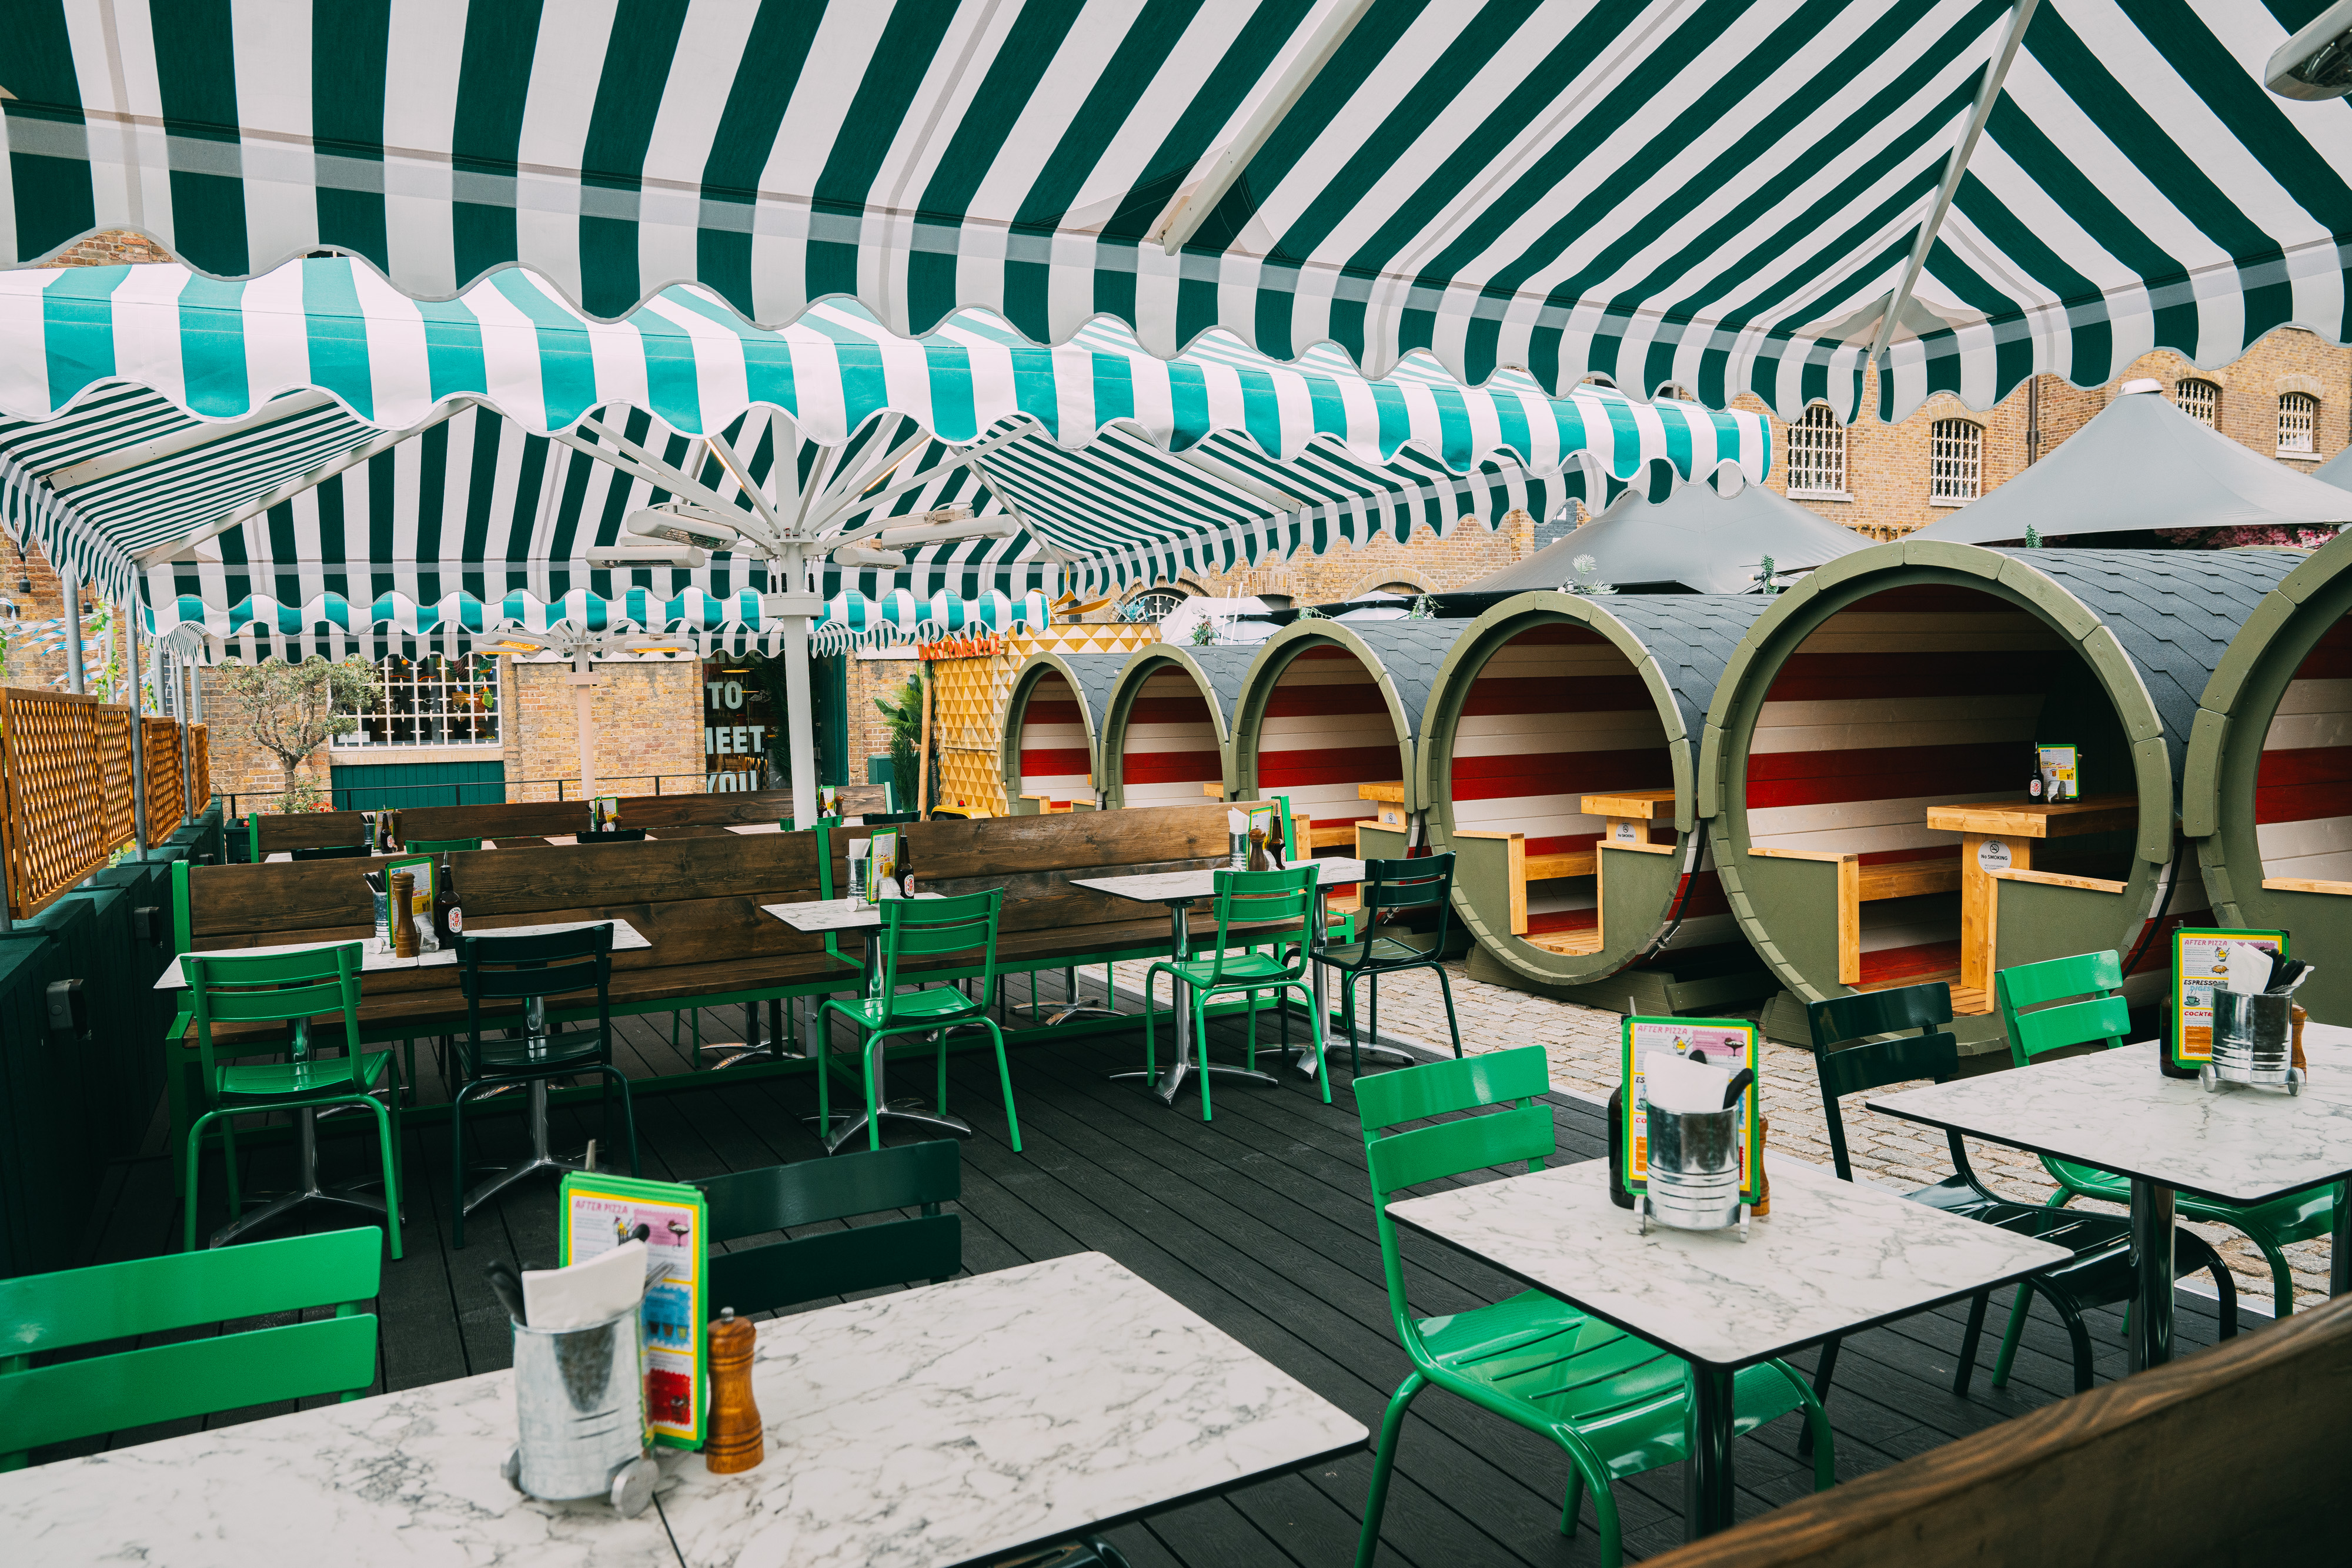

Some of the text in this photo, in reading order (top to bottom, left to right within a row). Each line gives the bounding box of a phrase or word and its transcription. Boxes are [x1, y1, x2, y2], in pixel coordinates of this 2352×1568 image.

[917, 636, 1001, 661] LUCKY PINEAPPLE
[707, 681, 743, 710] TO
[707, 770, 757, 793] YOU
[1638, 1025, 1688, 1035] AFTER PIZZA
[575, 1201, 628, 1214] AFTER PIZZA
